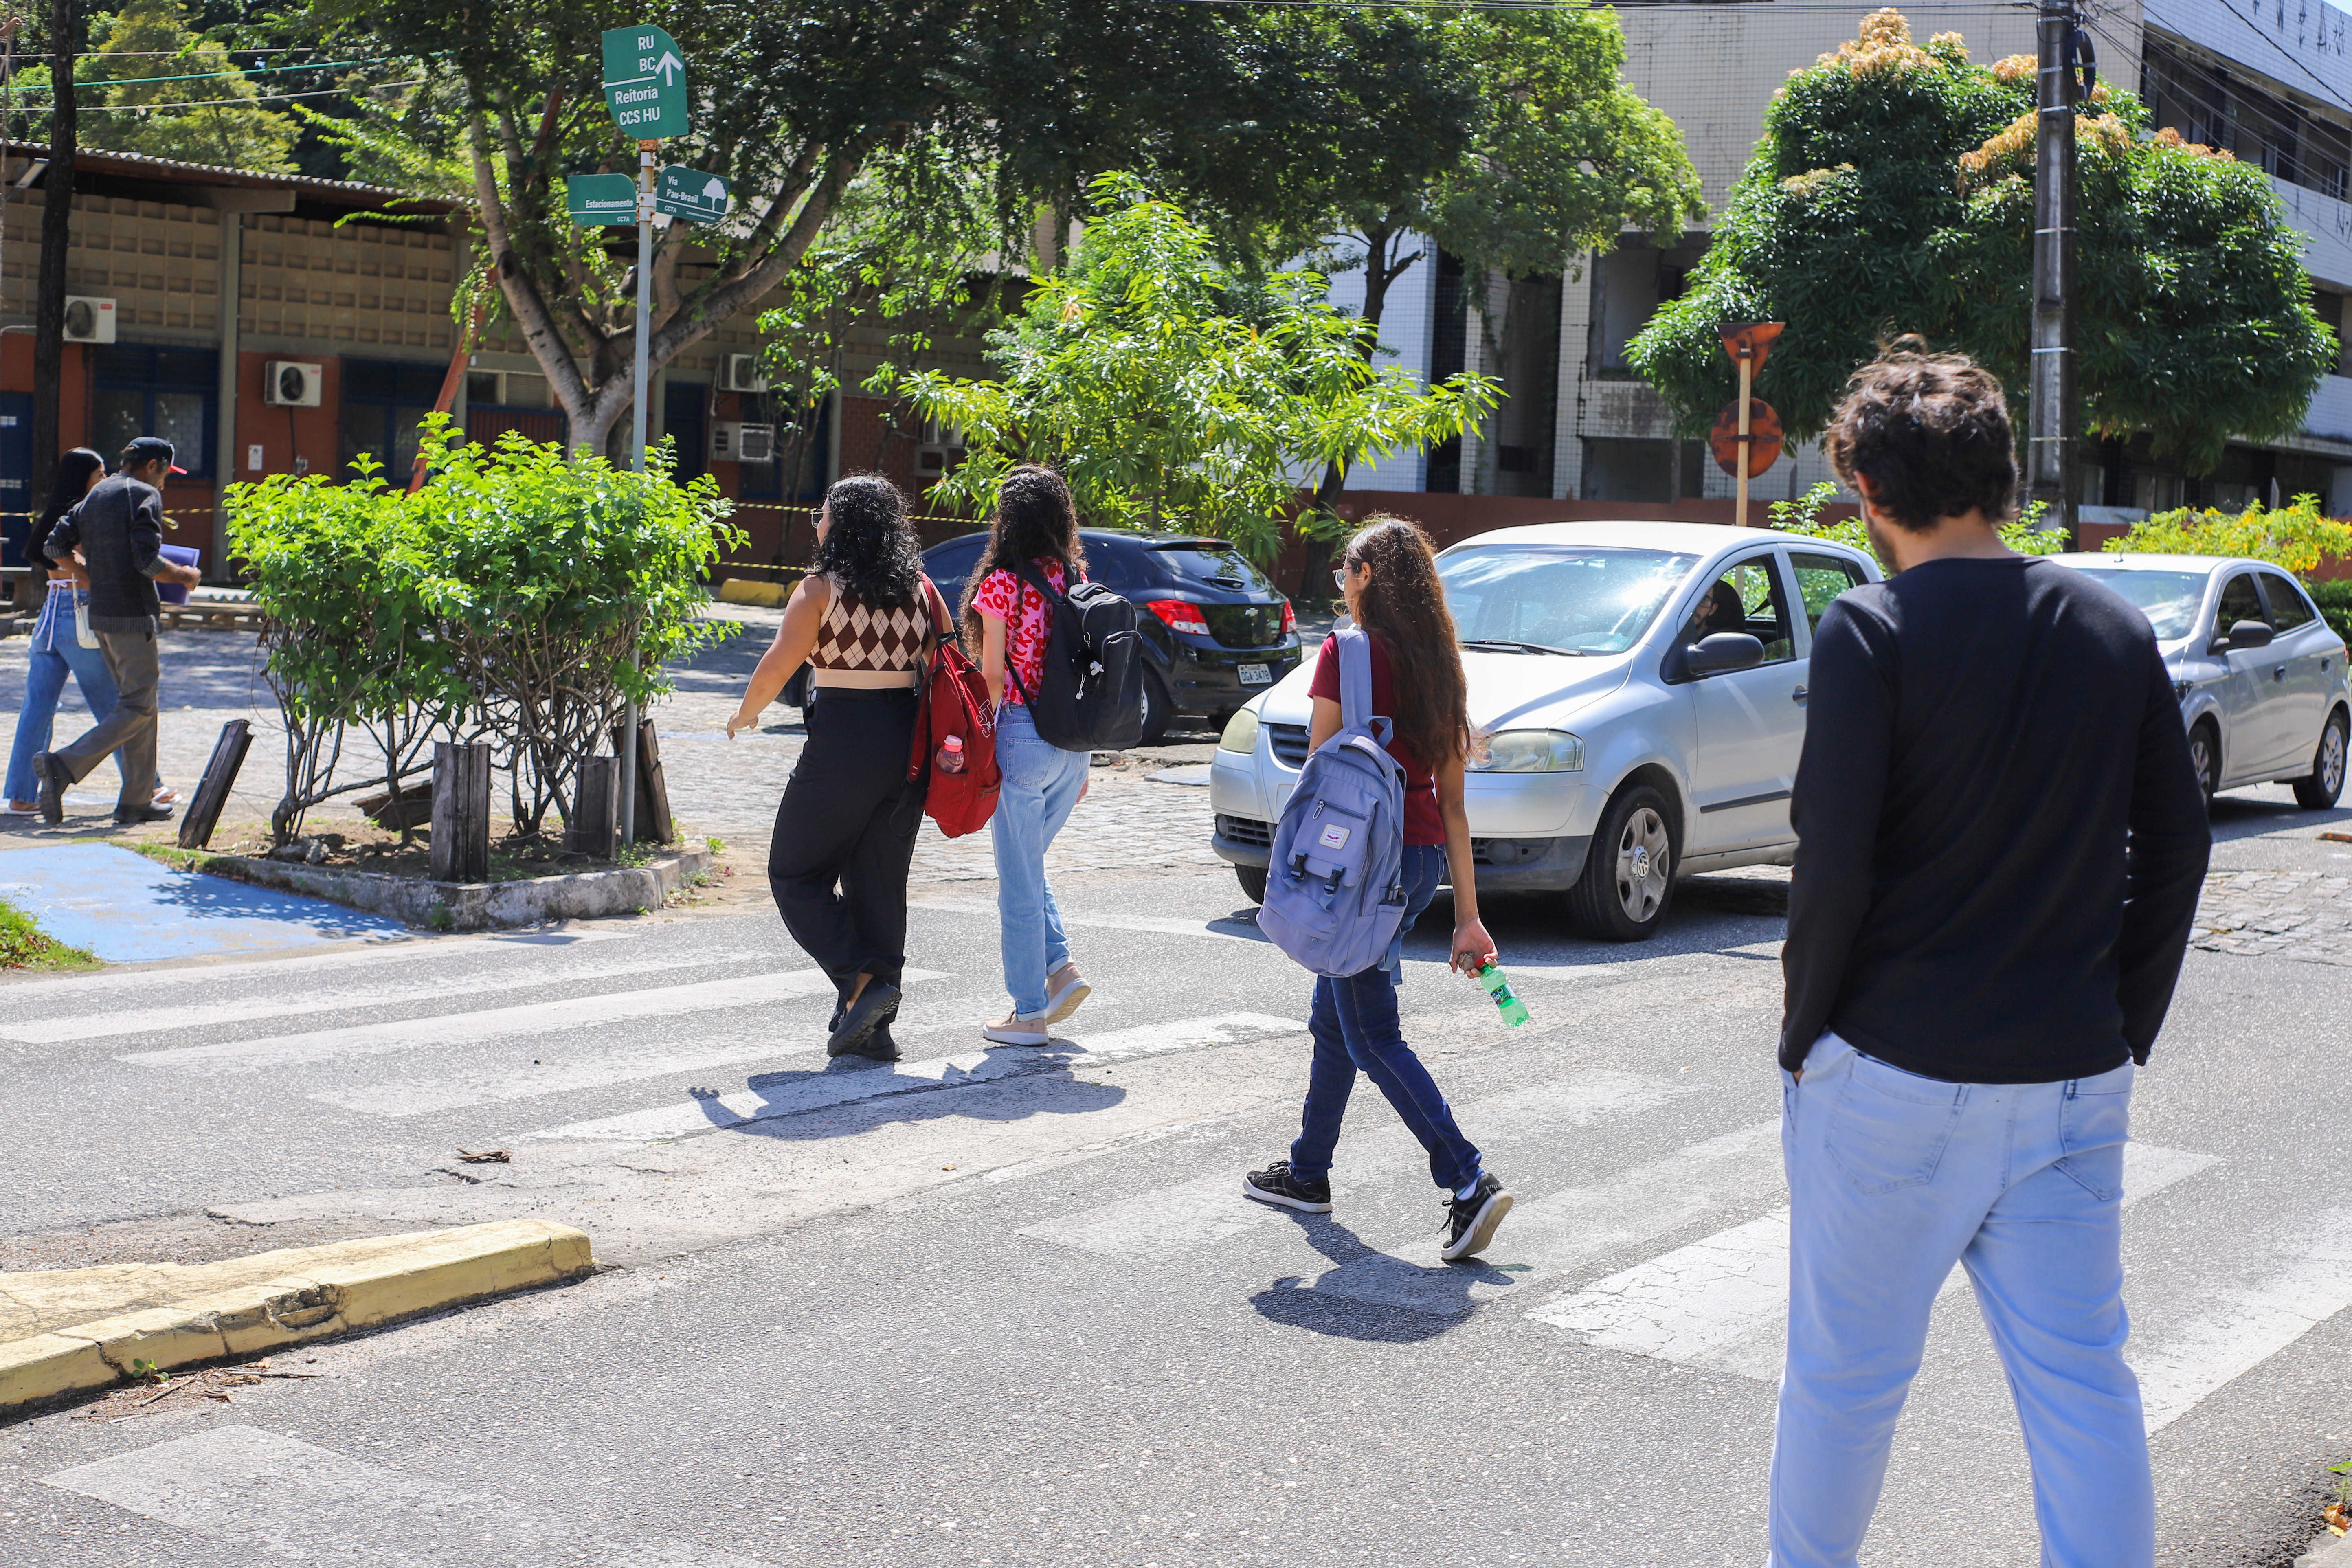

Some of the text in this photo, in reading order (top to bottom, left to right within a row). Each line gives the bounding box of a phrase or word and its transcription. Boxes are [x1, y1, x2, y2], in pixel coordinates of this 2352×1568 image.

[638, 35, 654, 51] RU
[639, 57, 656, 72] BC
[615, 85, 658, 105] Reitoria
[619, 106, 660, 125] CCS HU
[668, 175, 678, 186] Via
[666, 188, 699, 204] Pau-Brasil
[585, 199, 634, 209] Estacionamento
[664, 205, 677, 213] CCTA
